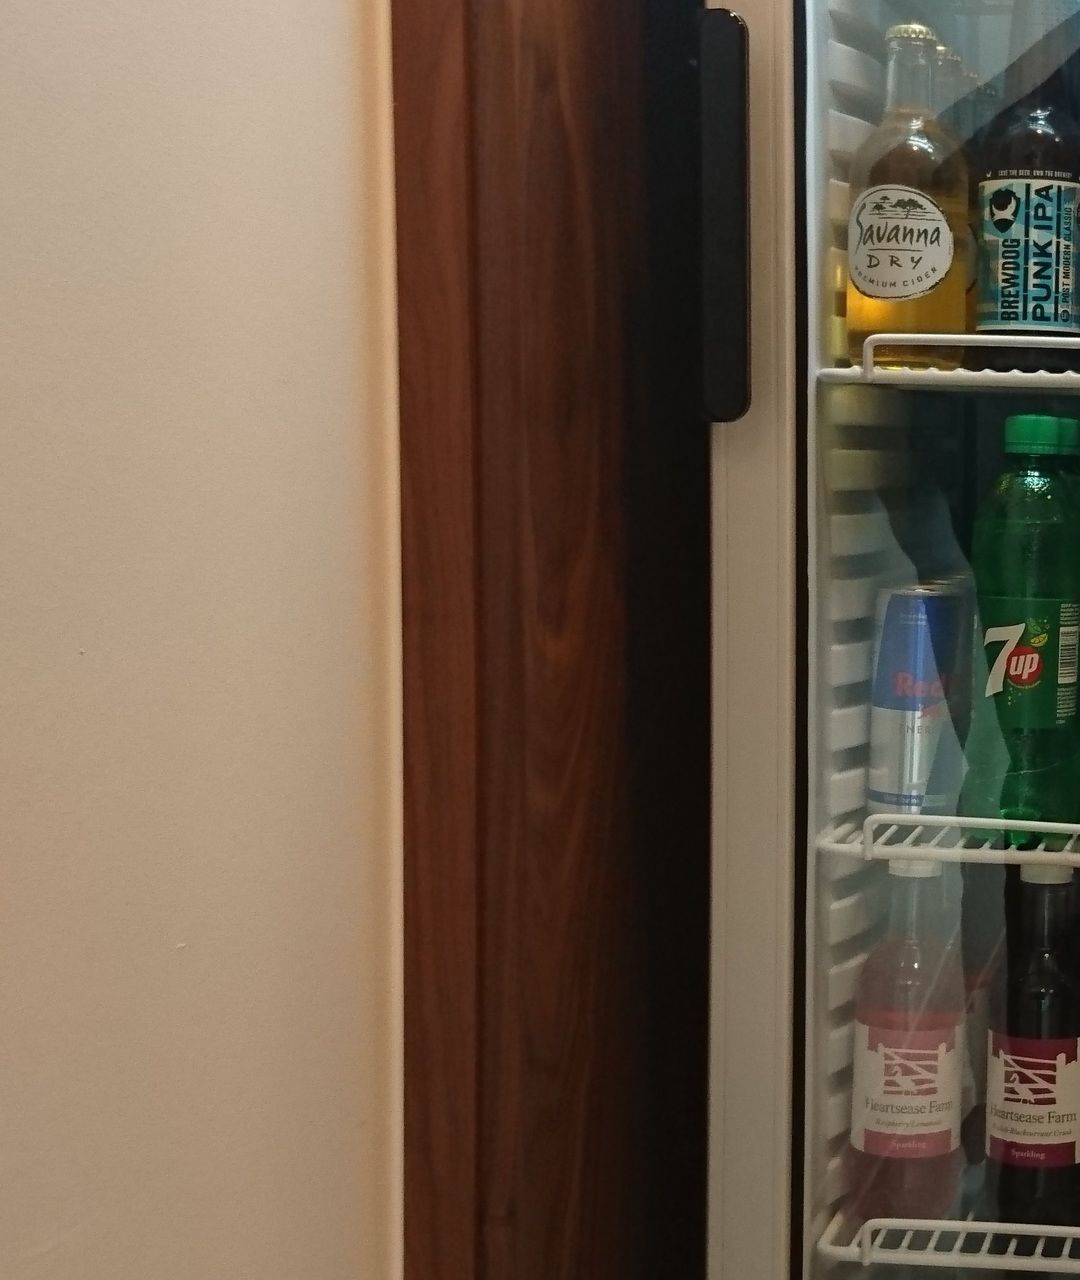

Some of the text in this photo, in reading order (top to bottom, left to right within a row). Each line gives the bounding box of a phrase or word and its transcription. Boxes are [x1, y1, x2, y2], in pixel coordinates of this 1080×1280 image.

[855, 202, 941, 256] Savanna
[1032, 184, 1053, 322] PUNK IPA
[1061, 207, 1072, 303] POST MODERN CLASSIC
[855, 266, 938, 288] PREMIUM CIDER
[1000, 238, 1021, 321] BREWDOG
[865, 1096, 952, 1115] Heartsease Farm
[990, 1105, 1078, 1124] Heartsease Farm
[1011, 1149, 1046, 1160] Sparkling
